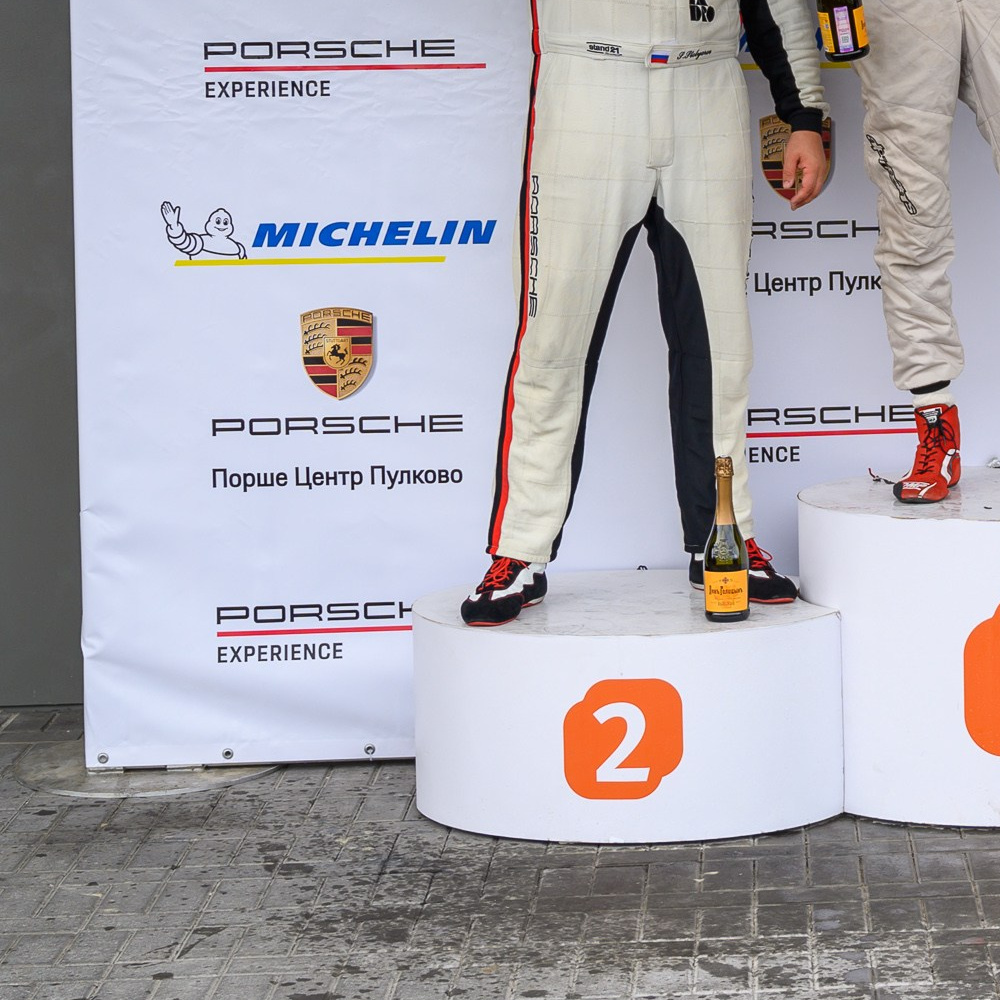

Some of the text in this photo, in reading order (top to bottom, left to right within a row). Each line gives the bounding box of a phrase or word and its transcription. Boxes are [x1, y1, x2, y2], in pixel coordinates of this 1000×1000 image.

[204, 39, 455, 60] PORSCHE
[206, 81, 330, 98] EXPERIENCE
[252, 220, 496, 248] MICHELIN
[529, 175, 538, 319] PORSCHE
[755, 273, 821, 296] Центр
[302, 309, 371, 323] PORSCHE
[212, 415, 463, 436] PORSCHE
[213, 466, 462, 492] Порше Центр Пулково
[218, 643, 342, 663] EXPERIENCE
[593, 702, 650, 782] 2
